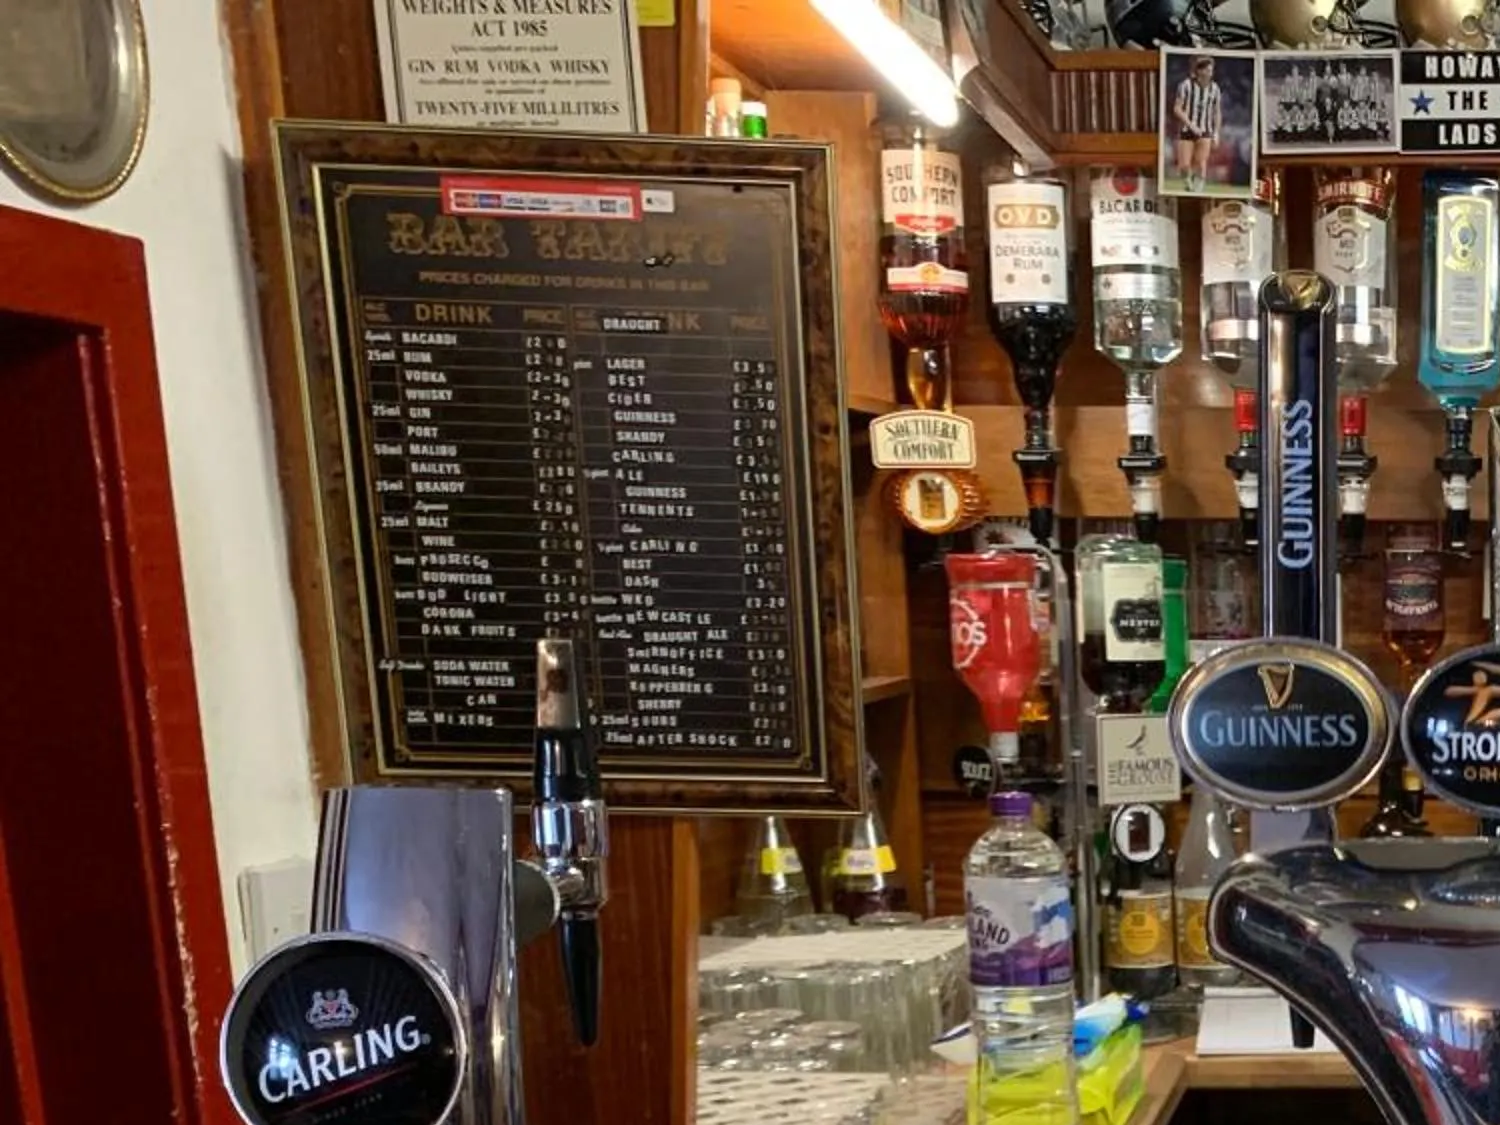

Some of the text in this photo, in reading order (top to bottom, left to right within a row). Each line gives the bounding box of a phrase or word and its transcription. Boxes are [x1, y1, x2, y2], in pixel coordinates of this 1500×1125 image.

[403, 0, 488, 14] WEIGHTS
[515, 0, 612, 15] MEASURES
[472, 19, 548, 36] ACT 1985
[408, 60, 609, 74] GIN RUM VODKA WHISKY
[1449, 90, 1489, 111] THE
[415, 101, 516, 116] TWENTY-FIVE
[1438, 122, 1498, 146] LADS
[887, 164, 959, 187] SOUHERN
[995, 245, 1059, 259] DEMERARA
[1013, 259, 1045, 271] RUM
[419, 271, 470, 286] PRICES
[415, 303, 494, 325] DRINK
[606, 358, 646, 370] LAGER
[405, 370, 447, 383] VODKA
[608, 374, 646, 388] BEST
[613, 410, 678, 425] GUINNESS
[407, 426, 439, 438] PORT
[410, 461, 462, 475] BAILEYS
[615, 468, 644, 482] ALE
[1277, 398, 1315, 569] GUINNESS
[625, 486, 688, 499] GUINNESS
[421, 535, 456, 548] WINE
[622, 558, 653, 570] BEST
[421, 571, 494, 585] BUDWEISER
[423, 605, 476, 620] CORONA
[433, 660, 511, 673] SODA WATER
[474, 676, 516, 688] WATER
[1200, 709, 1359, 749] GUINNESS
[258, 1015, 422, 1103] CARLING
